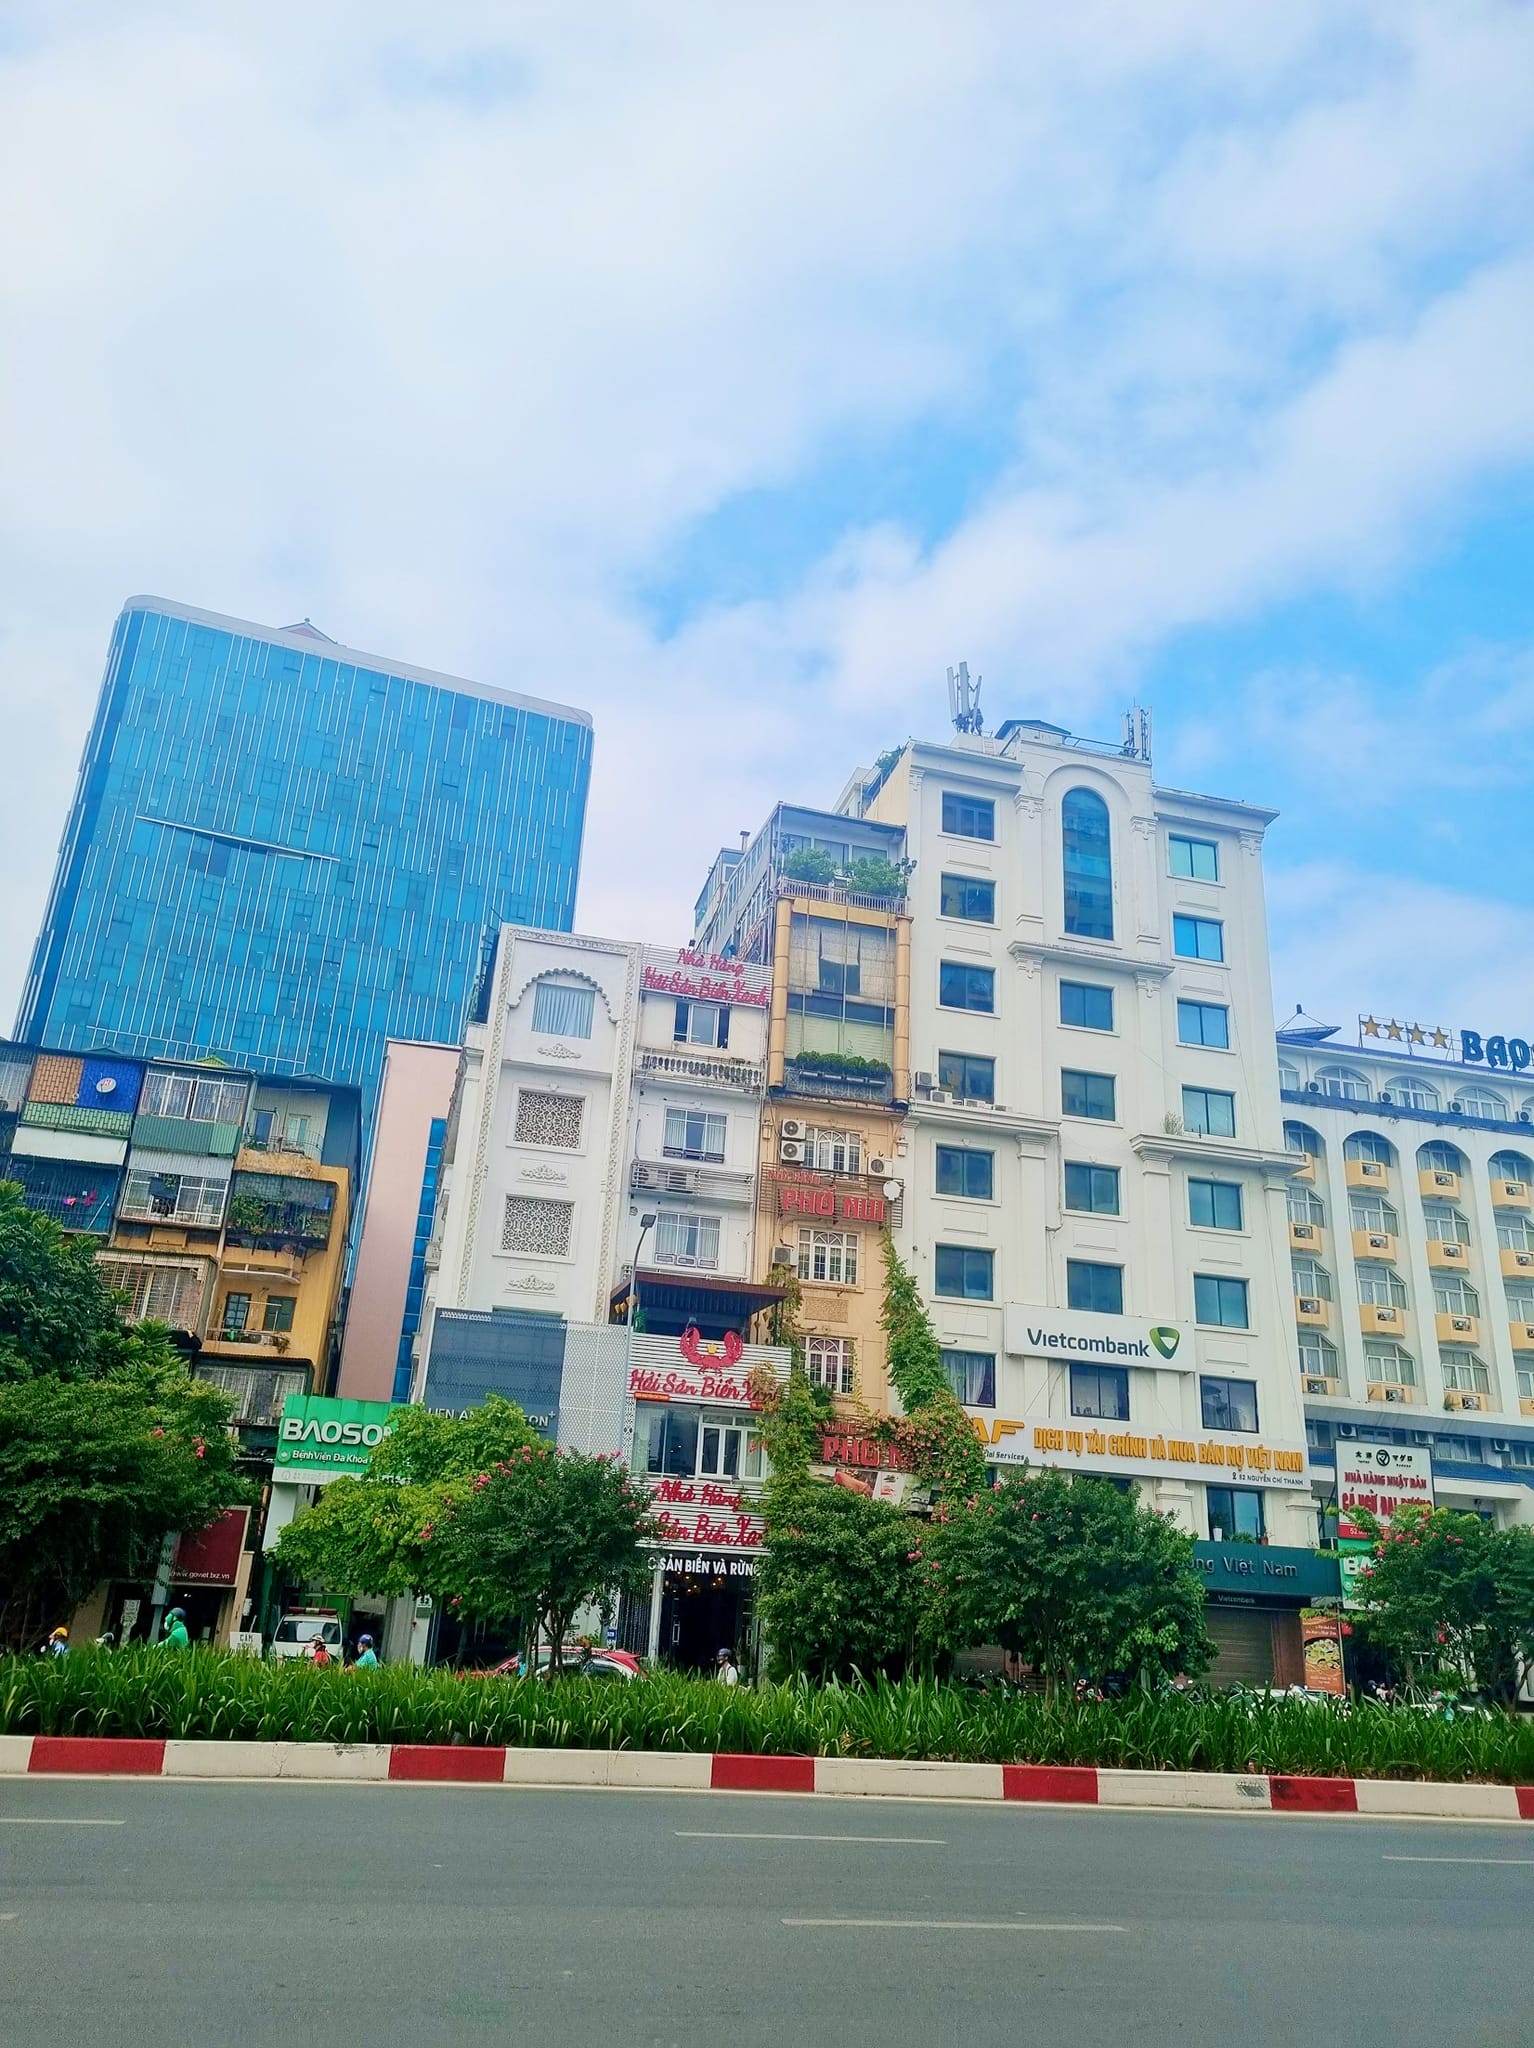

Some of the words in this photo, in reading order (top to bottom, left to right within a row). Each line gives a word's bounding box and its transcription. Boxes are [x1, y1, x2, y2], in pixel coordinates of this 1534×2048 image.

[677, 947, 706, 968] Nhà
[709, 954, 745, 977] Hàng
[733, 980, 768, 1006] Xanh
[1461, 1029, 1534, 1071] BAO
[1026, 1328, 1150, 1357] Vietcombank
[629, 1369, 661, 1391] Hải
[662, 1373, 697, 1396] Sản
[700, 1375, 740, 1399] Biển
[333, 1453, 345, 1462] Đa
[346, 1454, 368, 1464] Khoa
[1034, 1427, 1063, 1454] DỊCH
[1066, 1430, 1083, 1457] VỤ
[1085, 1428, 1105, 1455] TÀI
[1108, 1431, 1147, 1459] CHÍNH
[1149, 1434, 1167, 1460] VÀ
[1168, 1440, 1196, 1463] MUA
[1198, 1440, 1225, 1466] BÁN
[1226, 1445, 1244, 1471] NỢ
[1245, 1444, 1272, 1473] VIỆT
[1274, 1450, 1304, 1473] NAM
[1344, 1469, 1362, 1483] NHÀ
[1363, 1470, 1385, 1486] HÀNG
[657, 1480, 696, 1502] Nhà
[700, 1484, 743, 1512] Hàng
[693, 1514, 734, 1543] Biển
[660, 1553, 682, 1572] SẢN
[684, 1553, 710, 1574] BIỂN
[713, 1558, 728, 1575] VÀ
[1223, 1556, 1255, 1576] Việt
[1263, 1559, 1298, 1577] Nam
